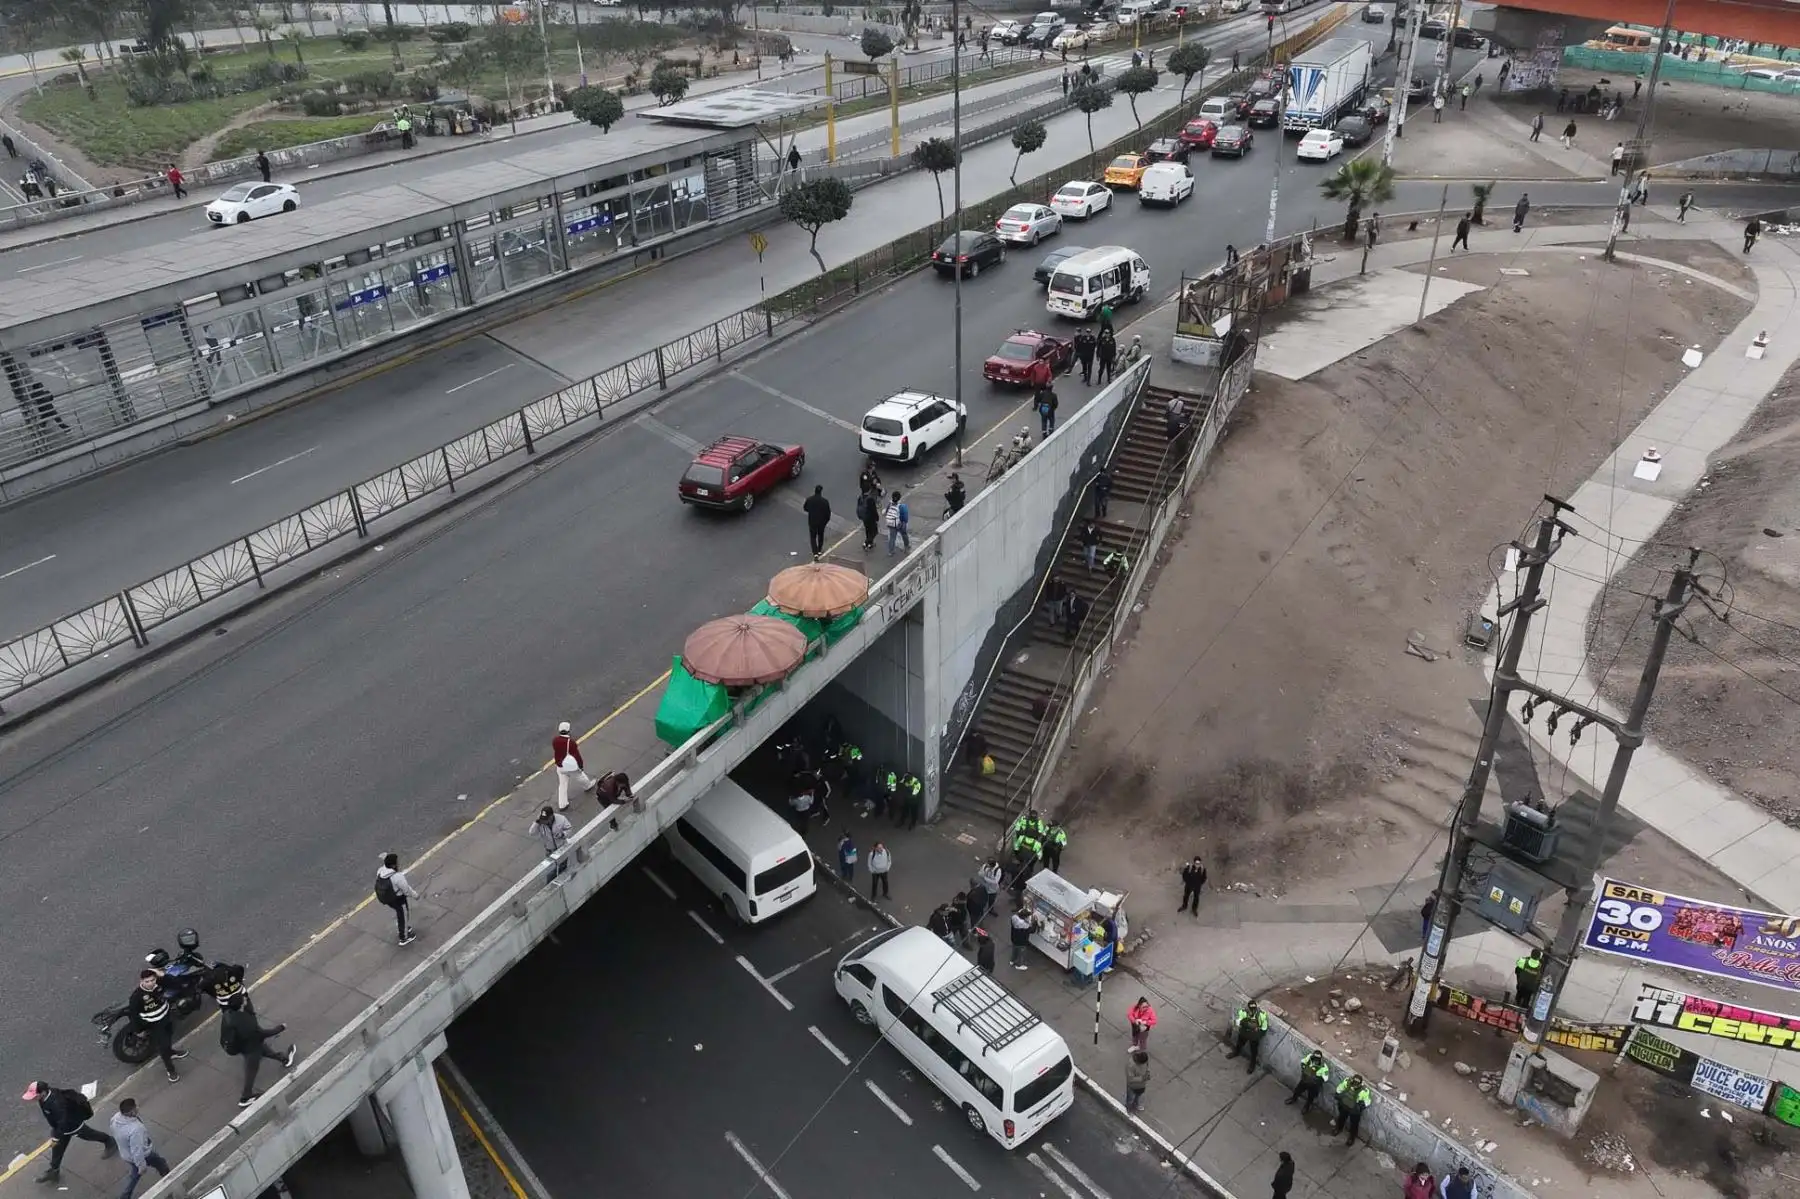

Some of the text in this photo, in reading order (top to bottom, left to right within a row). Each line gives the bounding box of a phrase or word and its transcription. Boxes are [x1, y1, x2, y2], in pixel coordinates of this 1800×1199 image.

[1612, 886, 1657, 904] SAB.
[1597, 900, 1662, 931] 30
[1597, 935, 1652, 953] 6 P.M.
[1605, 926, 1646, 941] NOV.
[1752, 934, 1797, 951] AÑOS
[1722, 951, 1780, 975] Bella
[1678, 1011, 1800, 1050] CENT
[1696, 1062, 1733, 1087] DULCE
